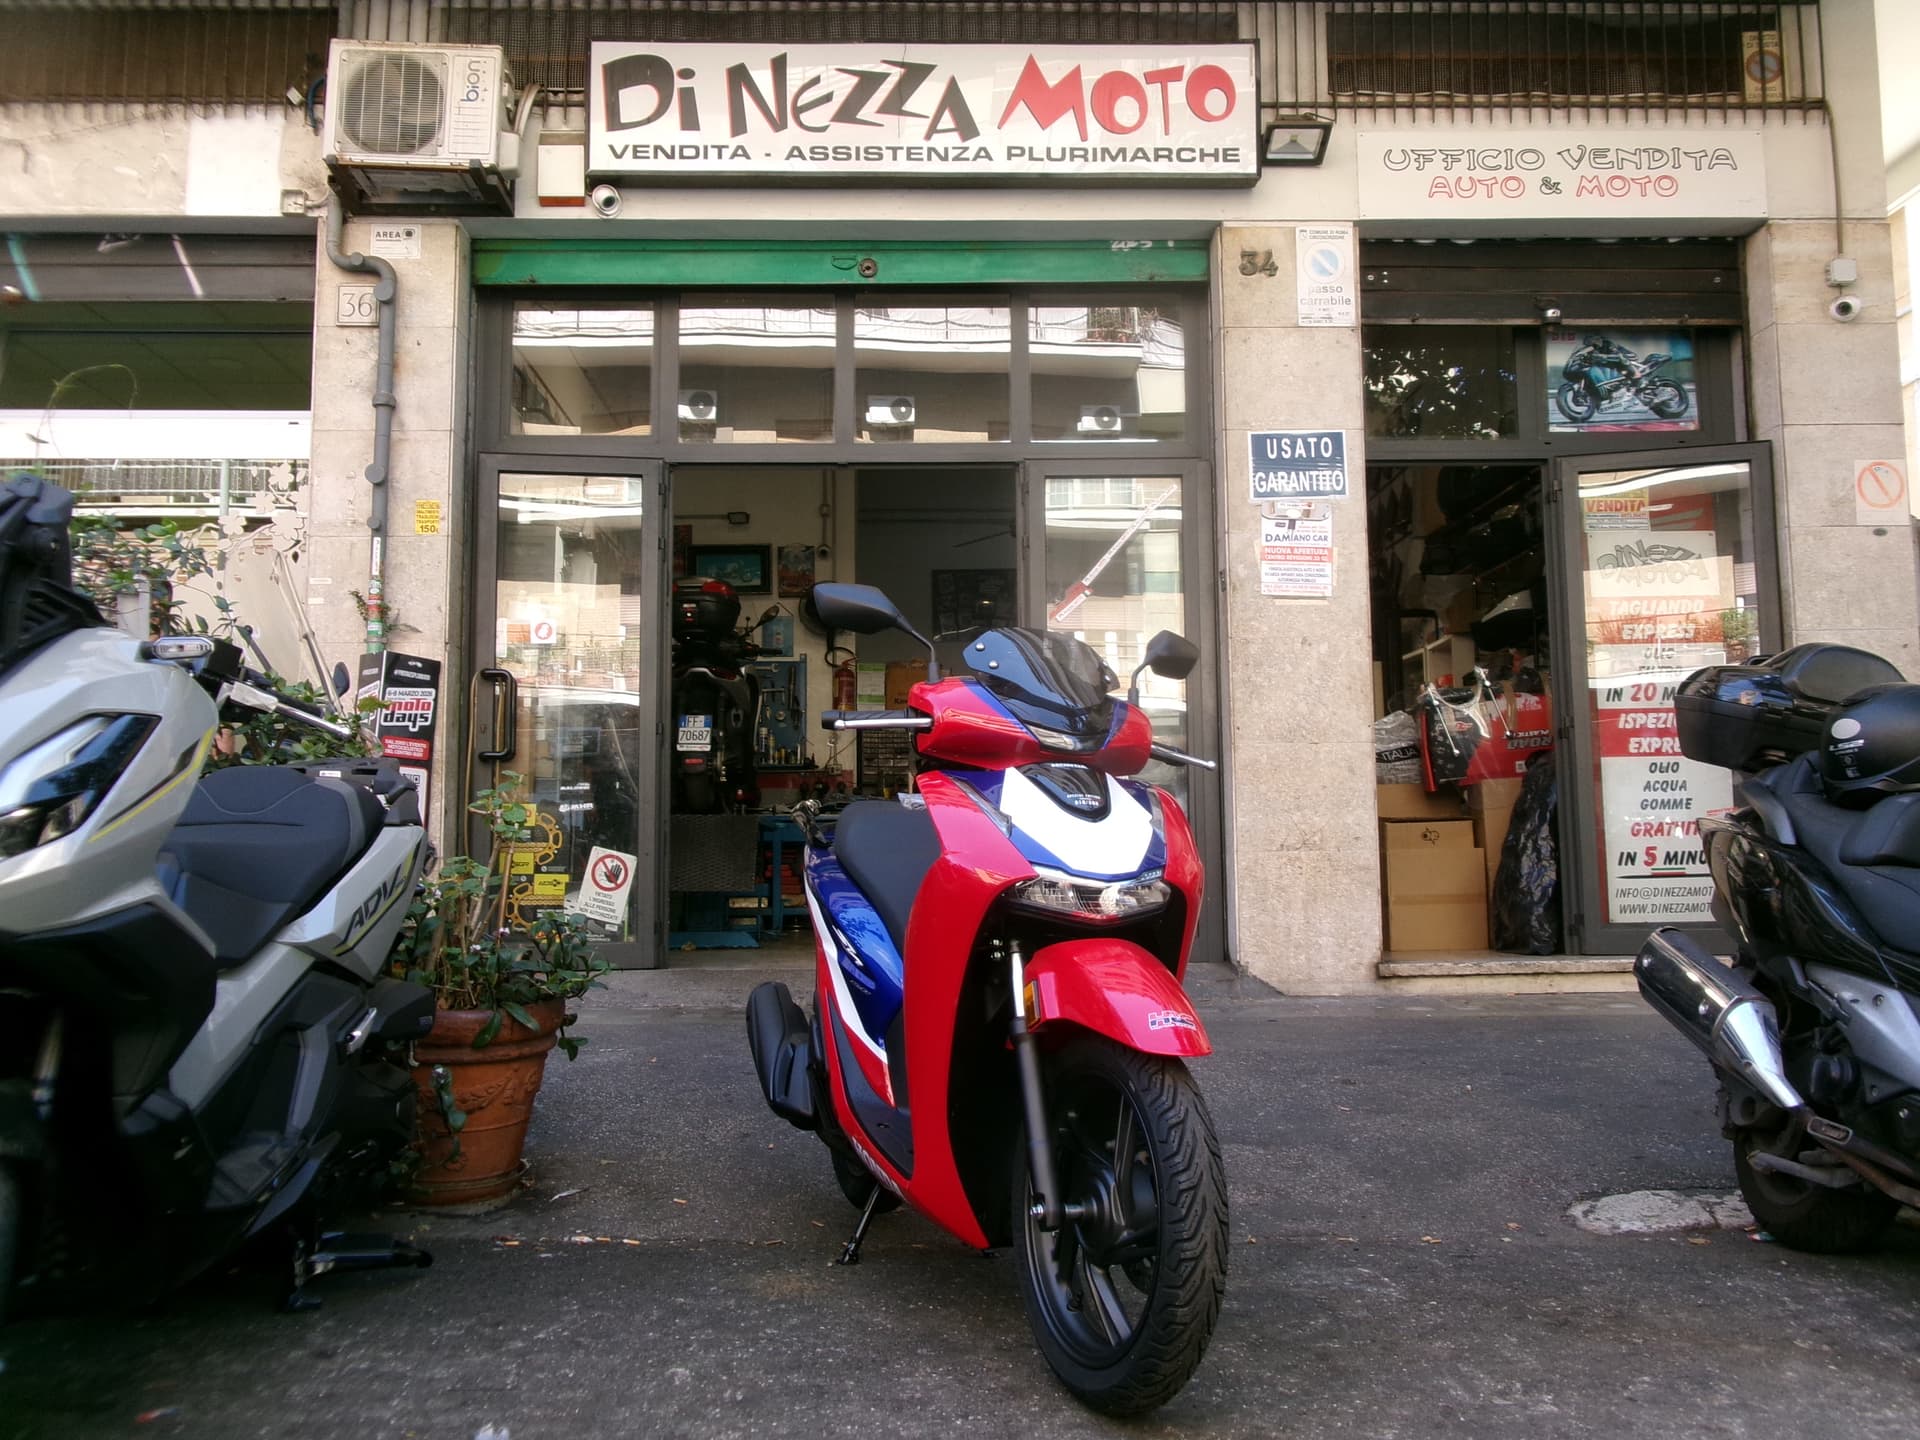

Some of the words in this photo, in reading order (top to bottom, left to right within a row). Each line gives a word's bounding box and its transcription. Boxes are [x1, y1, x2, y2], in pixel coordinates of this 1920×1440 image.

[460, 60, 481, 102] bion
[996, 53, 1238, 142] MOTO
[608, 145, 753, 162] VENDITA
[784, 145, 994, 163] ASSISTENZA
[1005, 146, 1241, 163] PLURIMARCHE
[1383, 148, 1546, 172] UFFICIO
[1556, 144, 1738, 171] VENDITA
[1428, 175, 1526, 199] AUTO
[1539, 176, 1562, 196] &
[1575, 174, 1679, 198] MOTO
[375, 231, 402, 239] AREA
[1238, 248, 1280, 278] 34
[340, 292, 374, 318] 36
[1299, 296, 1353, 306] carrabile
[1266, 436, 1333, 460] USATO
[1254, 469, 1344, 494] GARANTITO
[1586, 499, 1646, 512] VENDITA
[1265, 533, 1311, 543] DAMIANO
[1312, 533, 1329, 543] CAR
[1608, 600, 1705, 616] TAGLIANDO
[1606, 688, 1623, 702] IN
[1630, 682, 1657, 702] 20
[383, 711, 431, 729] days
[1648, 761, 1681, 774] OLIO
[1643, 779, 1688, 793] ACQUA
[1640, 798, 1694, 811] GOMME
[1617, 851, 1638, 867] IN
[1643, 845, 1658, 868] 5
[1662, 849, 1706, 866] MINU
[1615, 885, 1714, 900] INFO@DINEZZAMOT
[344, 863, 402, 943] ADV
[1619, 902, 1712, 915] WWW.DINEZZAMOT
